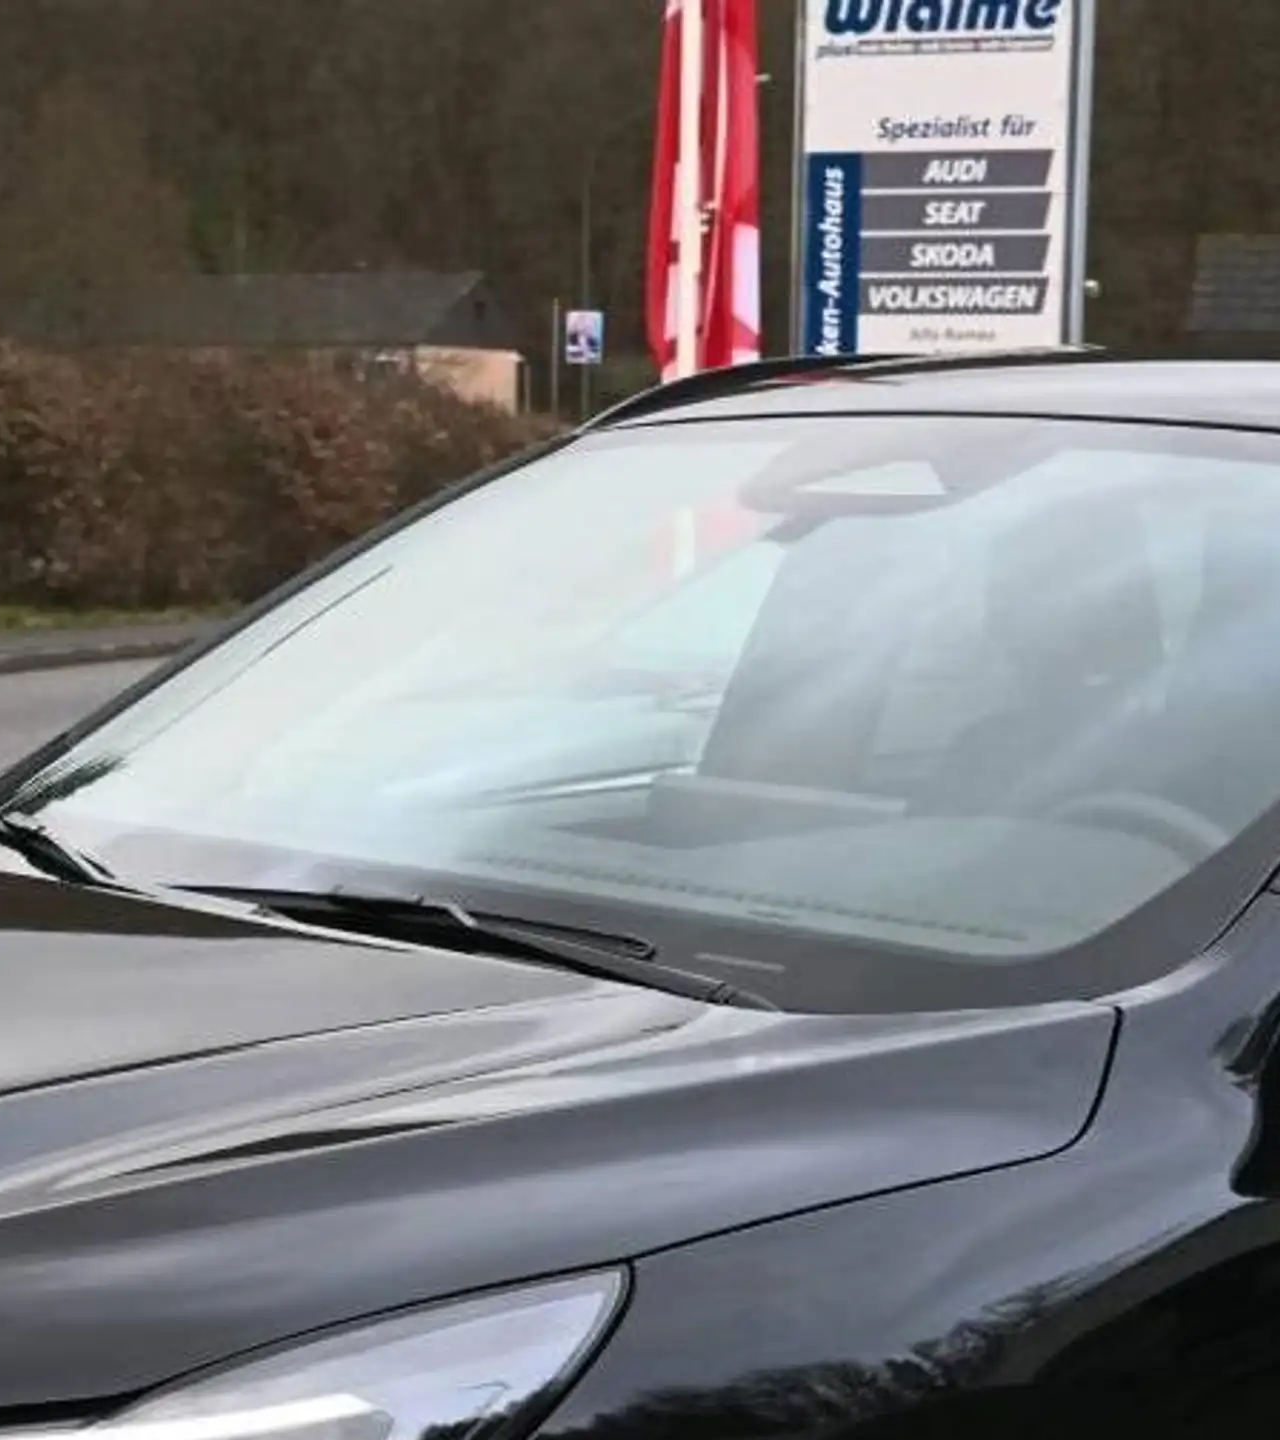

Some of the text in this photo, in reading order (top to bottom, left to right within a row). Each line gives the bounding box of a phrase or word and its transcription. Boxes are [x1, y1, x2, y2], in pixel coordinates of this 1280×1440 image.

[877, 114, 1036, 141] Spezialist für
[922, 159, 988, 182] AUDI
[923, 200, 987, 225] SEAT
[910, 243, 995, 267] SKODA
[868, 285, 1038, 309] VOLKSWAGEN
